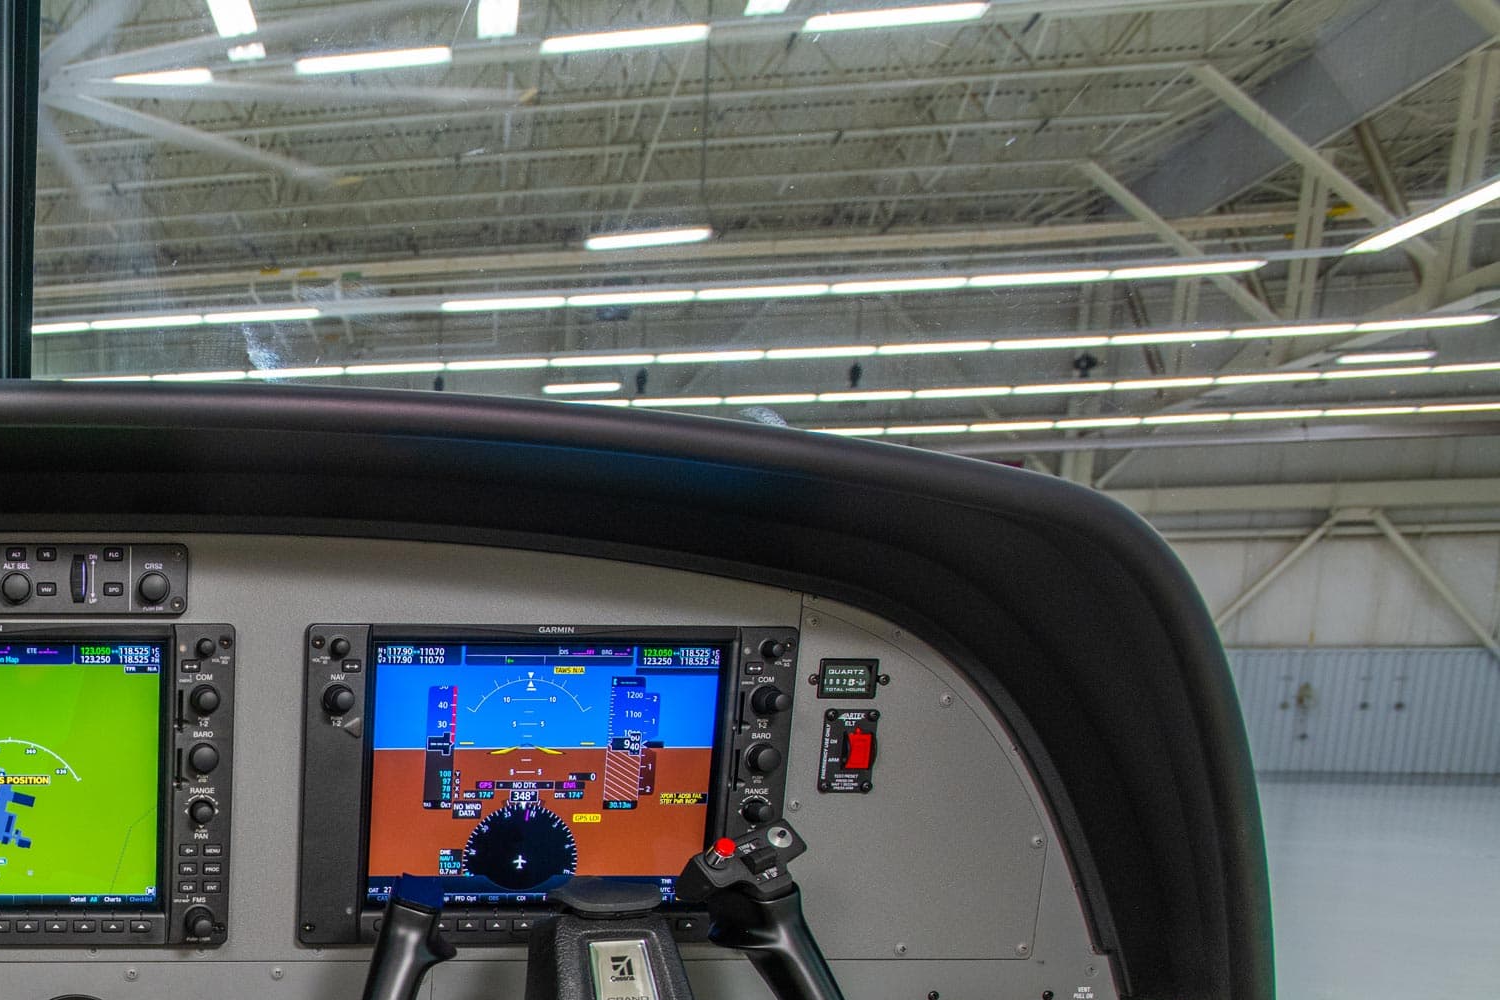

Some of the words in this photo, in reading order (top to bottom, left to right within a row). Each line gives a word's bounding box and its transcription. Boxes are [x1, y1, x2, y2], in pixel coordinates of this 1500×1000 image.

[119, 647, 149, 655] 118.525
[5, 656, 19, 664] Map
[80, 656, 111, 664] 123.250
[514, 792, 534, 800] 348°
